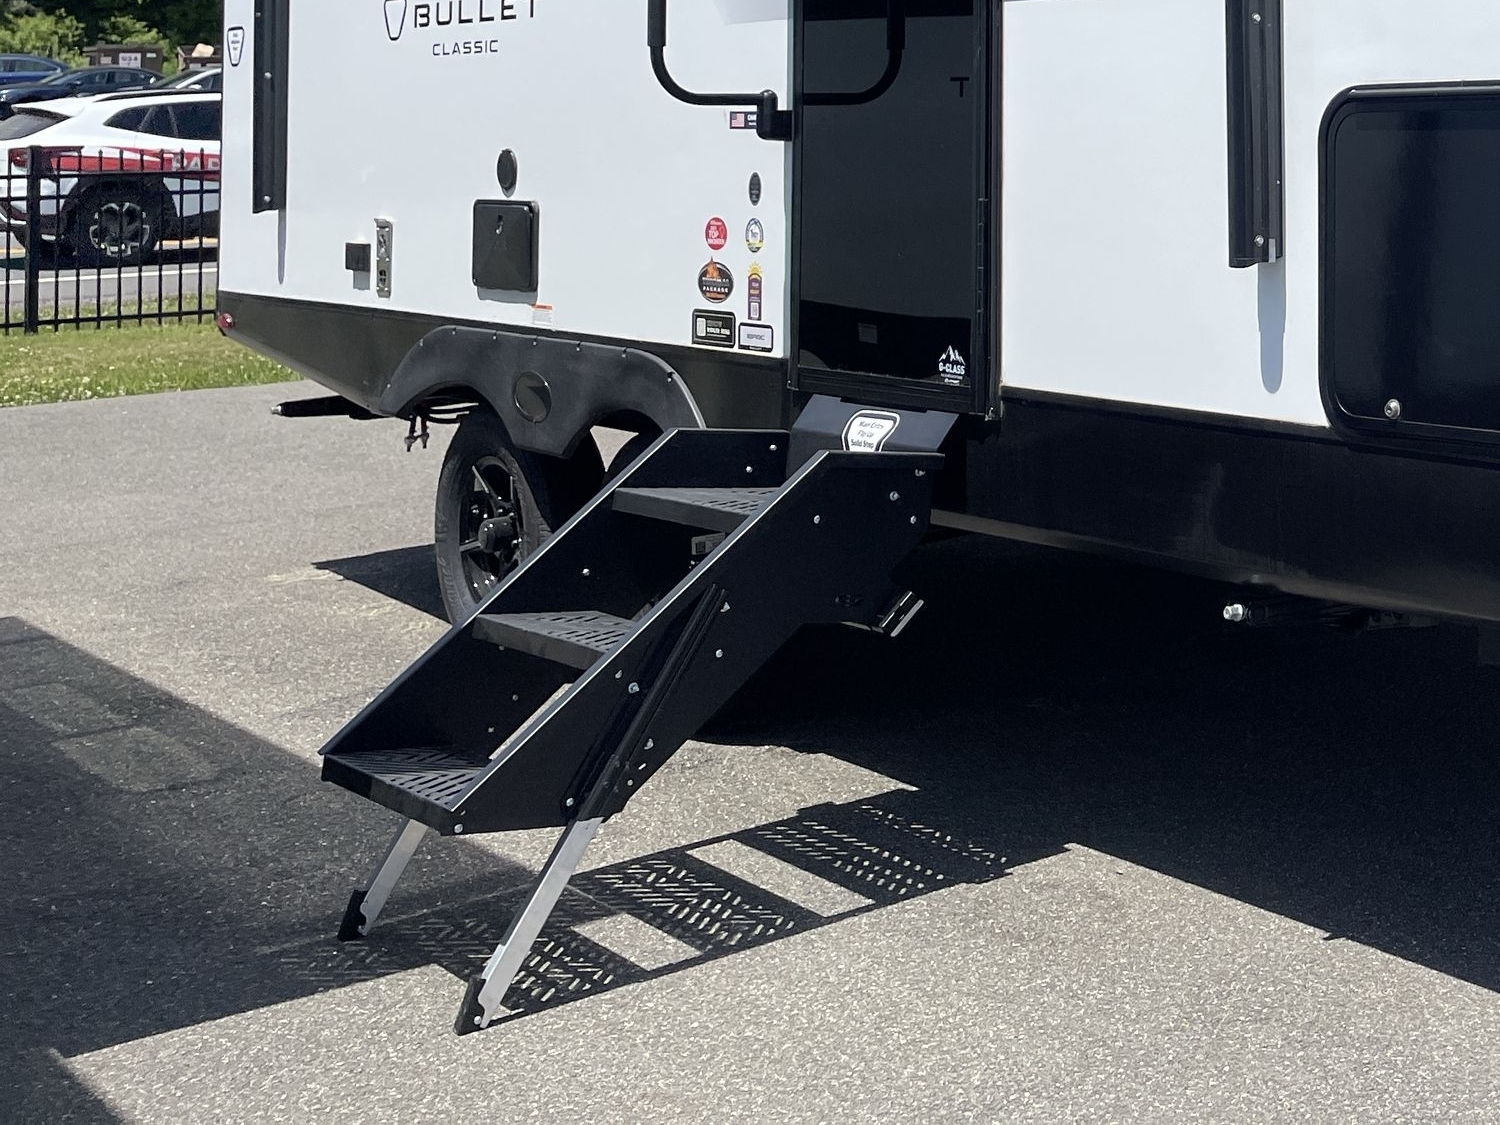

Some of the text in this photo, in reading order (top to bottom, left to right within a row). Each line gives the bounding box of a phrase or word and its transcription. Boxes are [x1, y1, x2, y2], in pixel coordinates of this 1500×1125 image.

[432, 40, 499, 56] CLASSIC
[851, 439, 874, 449] Solid Step
